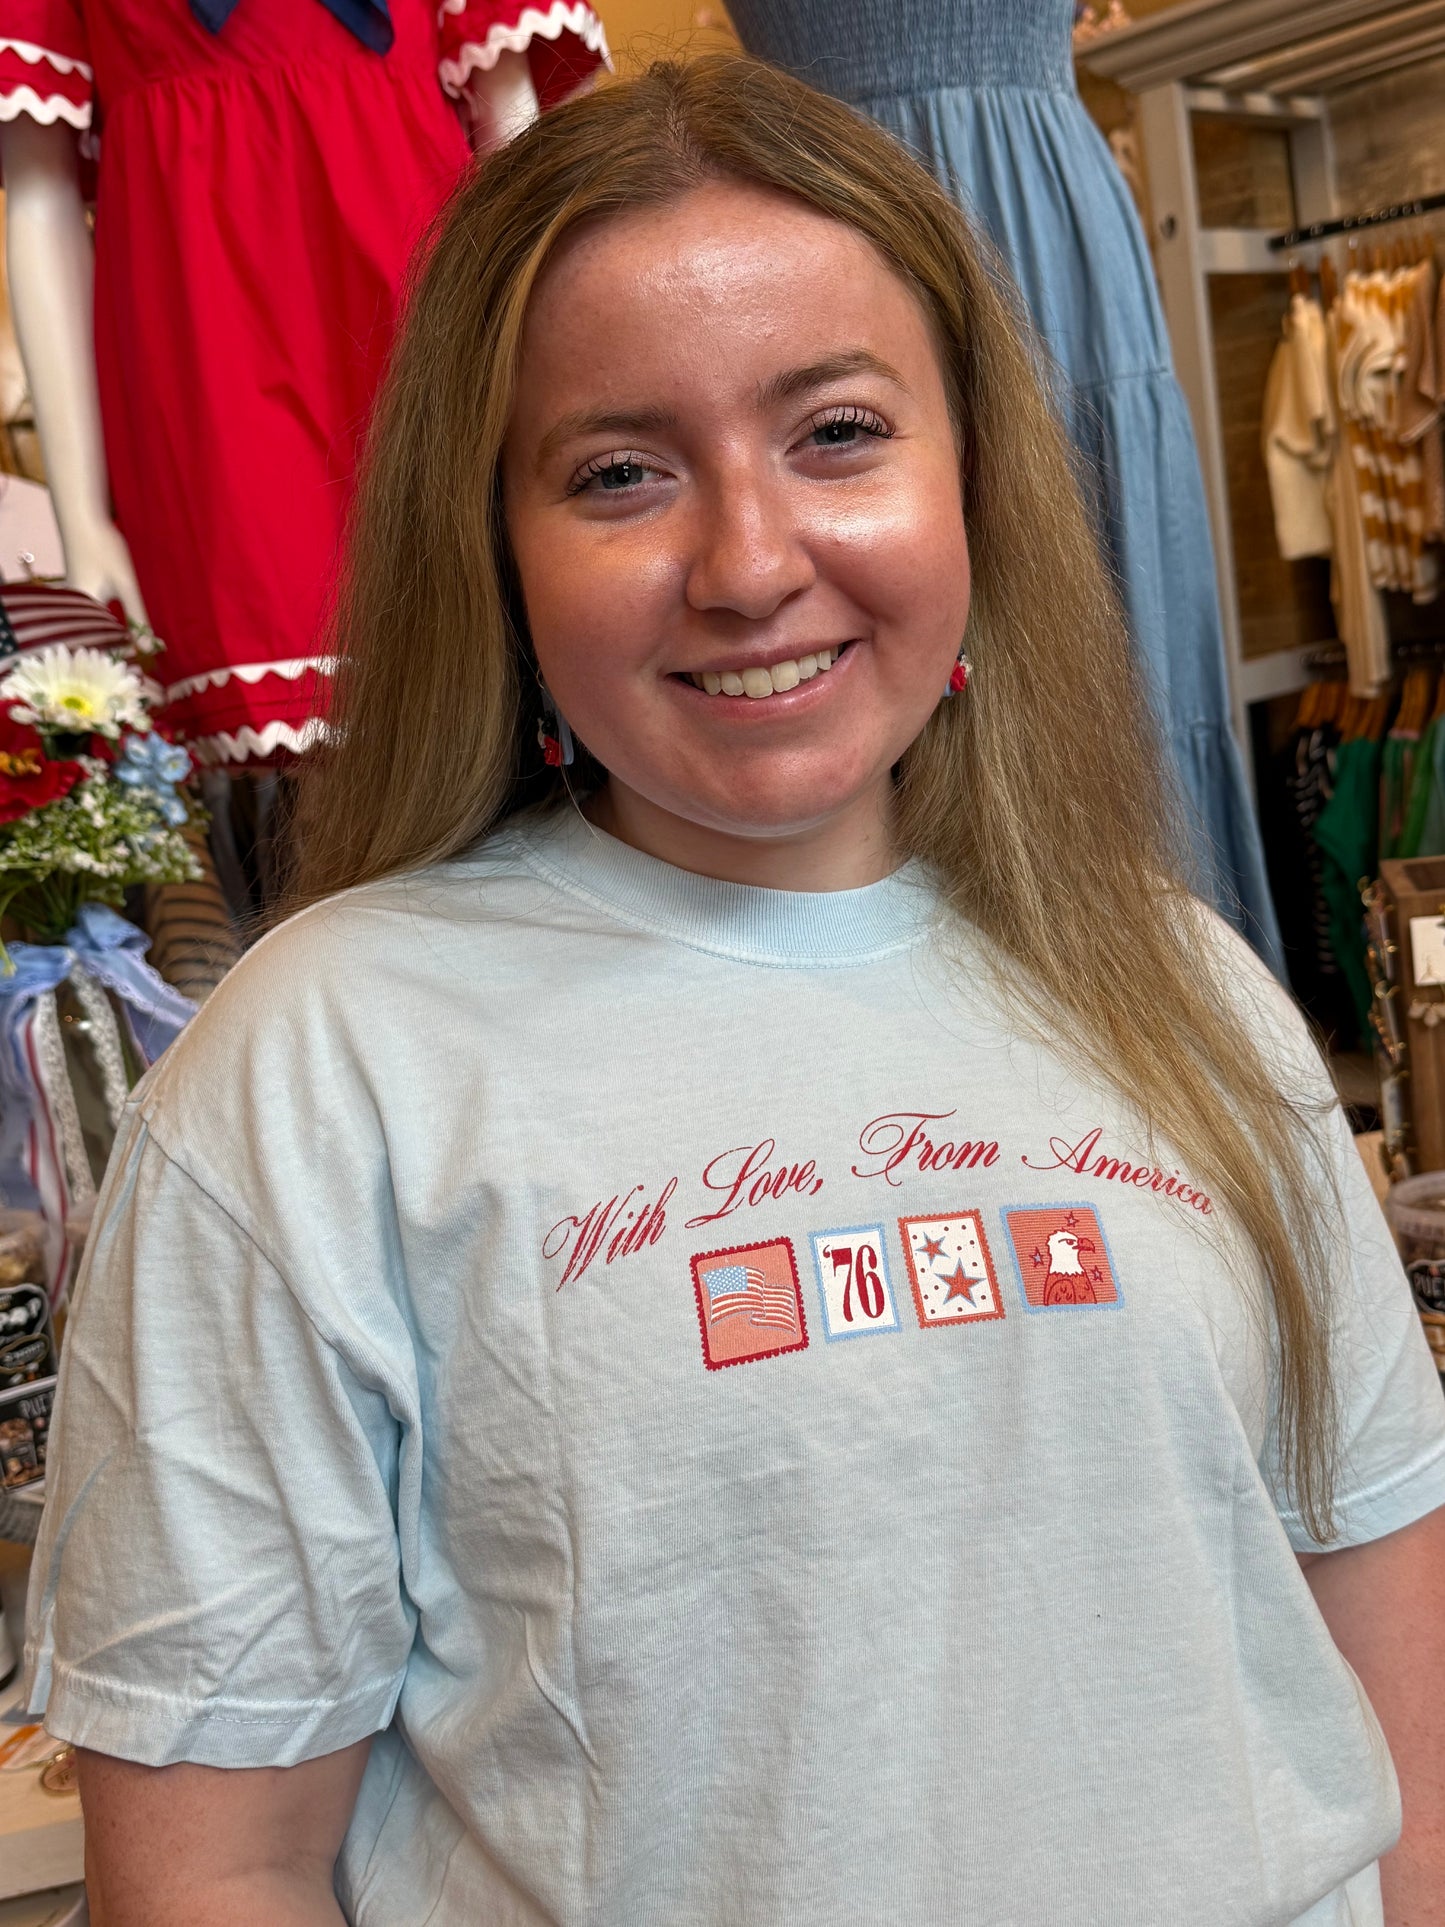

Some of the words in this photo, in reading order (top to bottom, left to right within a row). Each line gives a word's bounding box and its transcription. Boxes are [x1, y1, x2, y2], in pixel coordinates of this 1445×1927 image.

[542, 1177, 678, 1292] With
[685, 1138, 824, 1229] Love,
[851, 1109, 1000, 1186] From
[1021, 1127, 1212, 1214] America
